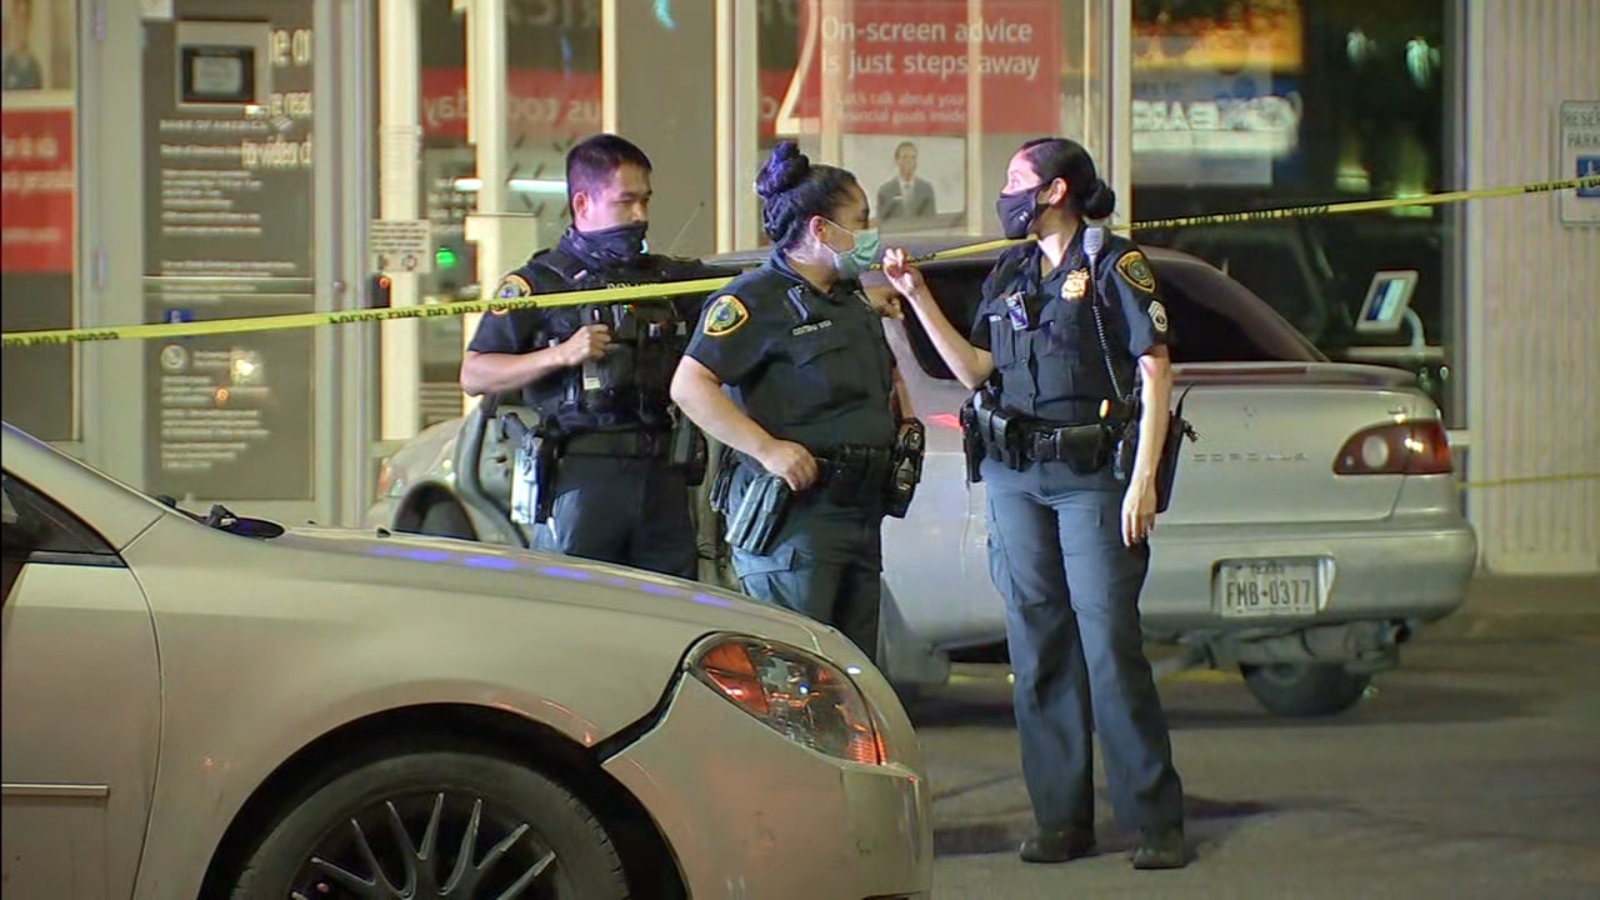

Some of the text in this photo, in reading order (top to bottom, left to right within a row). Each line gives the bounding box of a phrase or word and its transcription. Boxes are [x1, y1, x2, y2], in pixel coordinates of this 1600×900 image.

[821, 16, 1033, 43] On-screen advice
[848, 51, 894, 78] just
[903, 53, 968, 79] steps
[977, 56, 1040, 80] away
[898, 91, 934, 105] about
[938, 94, 965, 109] your
